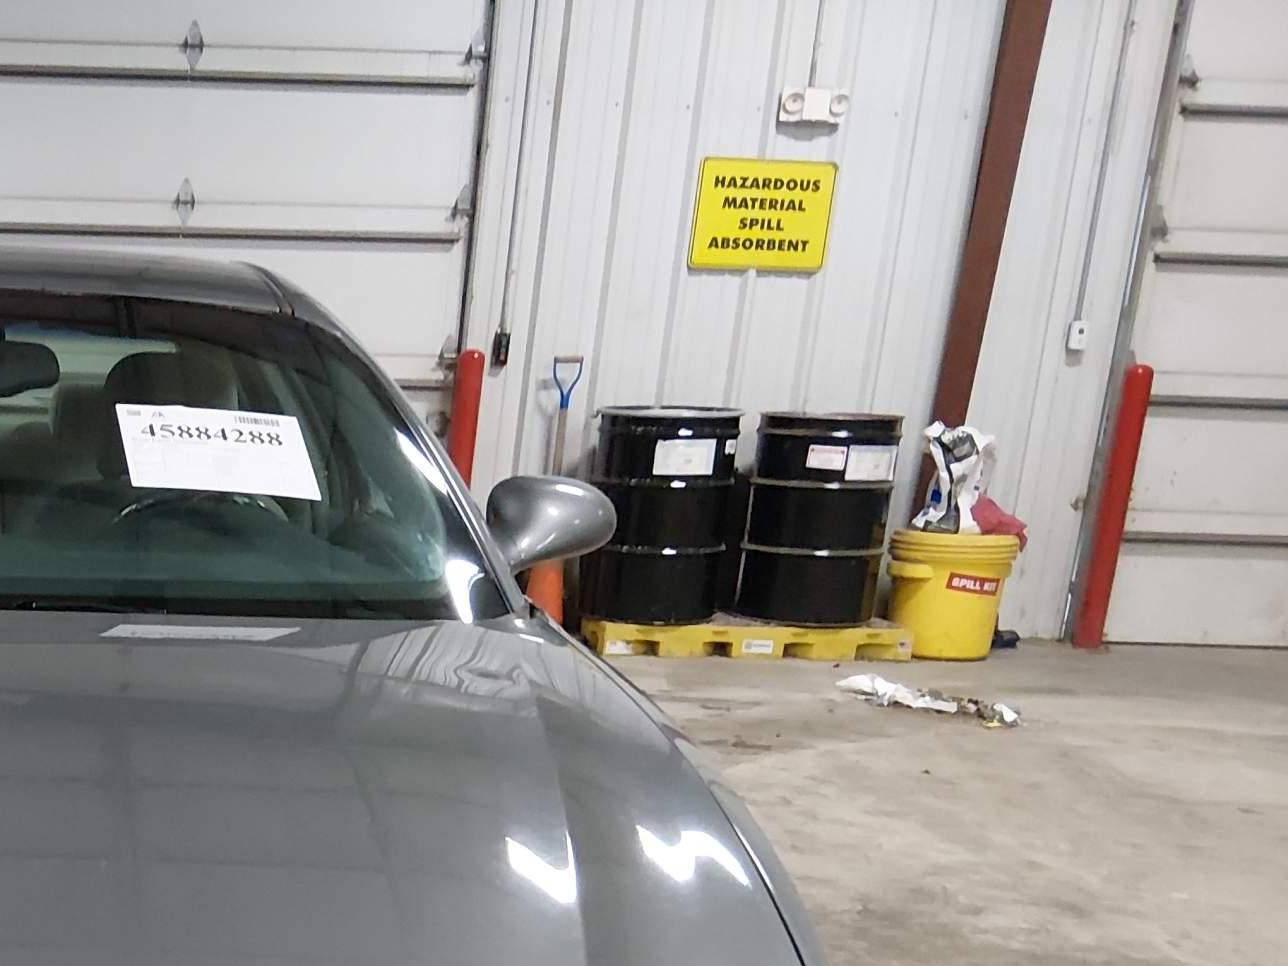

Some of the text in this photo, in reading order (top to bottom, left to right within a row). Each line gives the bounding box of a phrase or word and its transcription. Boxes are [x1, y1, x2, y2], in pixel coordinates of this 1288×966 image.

[713, 175, 821, 193] HAZARDOUS
[721, 196, 806, 212] MATERIAL
[738, 217, 784, 231] SPILL
[707, 236, 810, 253] ABSORBENT
[140, 423, 283, 446] 45884288
[952, 577, 981, 591] SPILL
